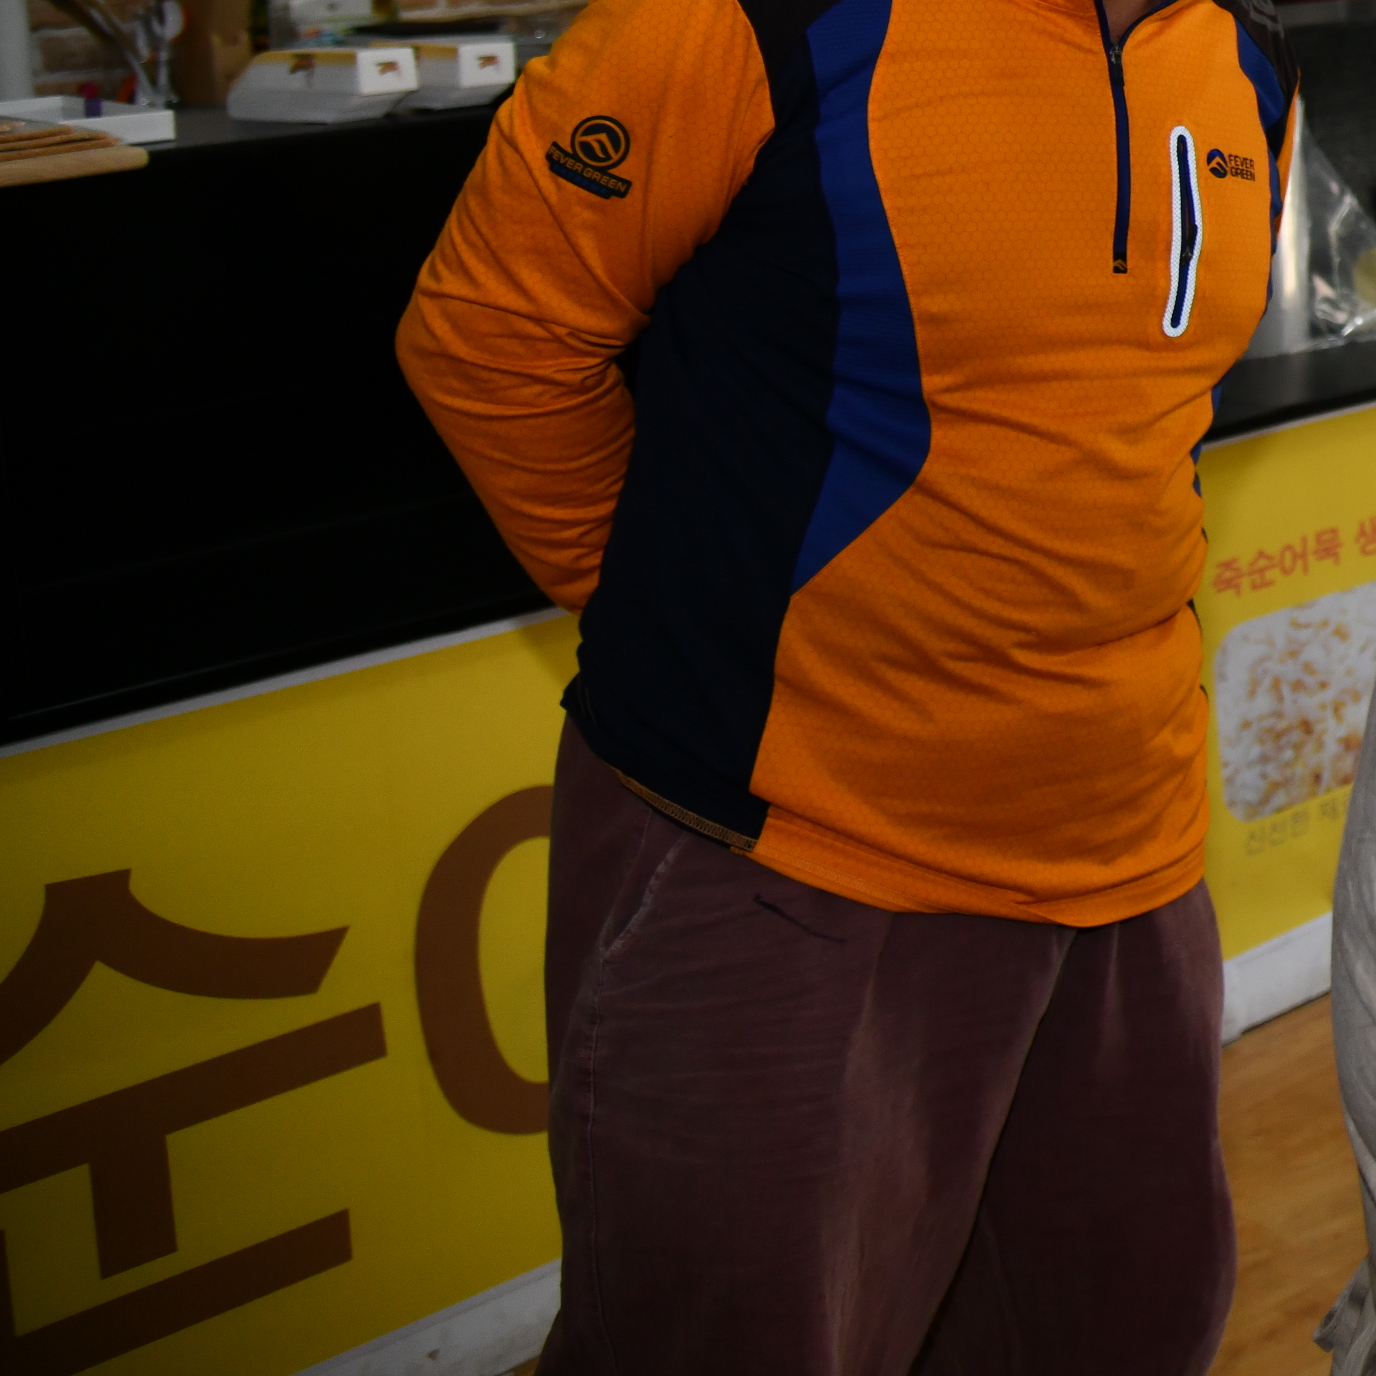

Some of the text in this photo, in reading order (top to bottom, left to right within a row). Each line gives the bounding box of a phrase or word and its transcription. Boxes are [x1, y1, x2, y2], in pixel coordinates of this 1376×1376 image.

[548, 145, 627, 193] FEVER GREEN
[1228, 152, 1255, 170] FEVER
[1229, 165, 1256, 182] GREEN
[1212, 527, 1345, 598] 죽순어묵
